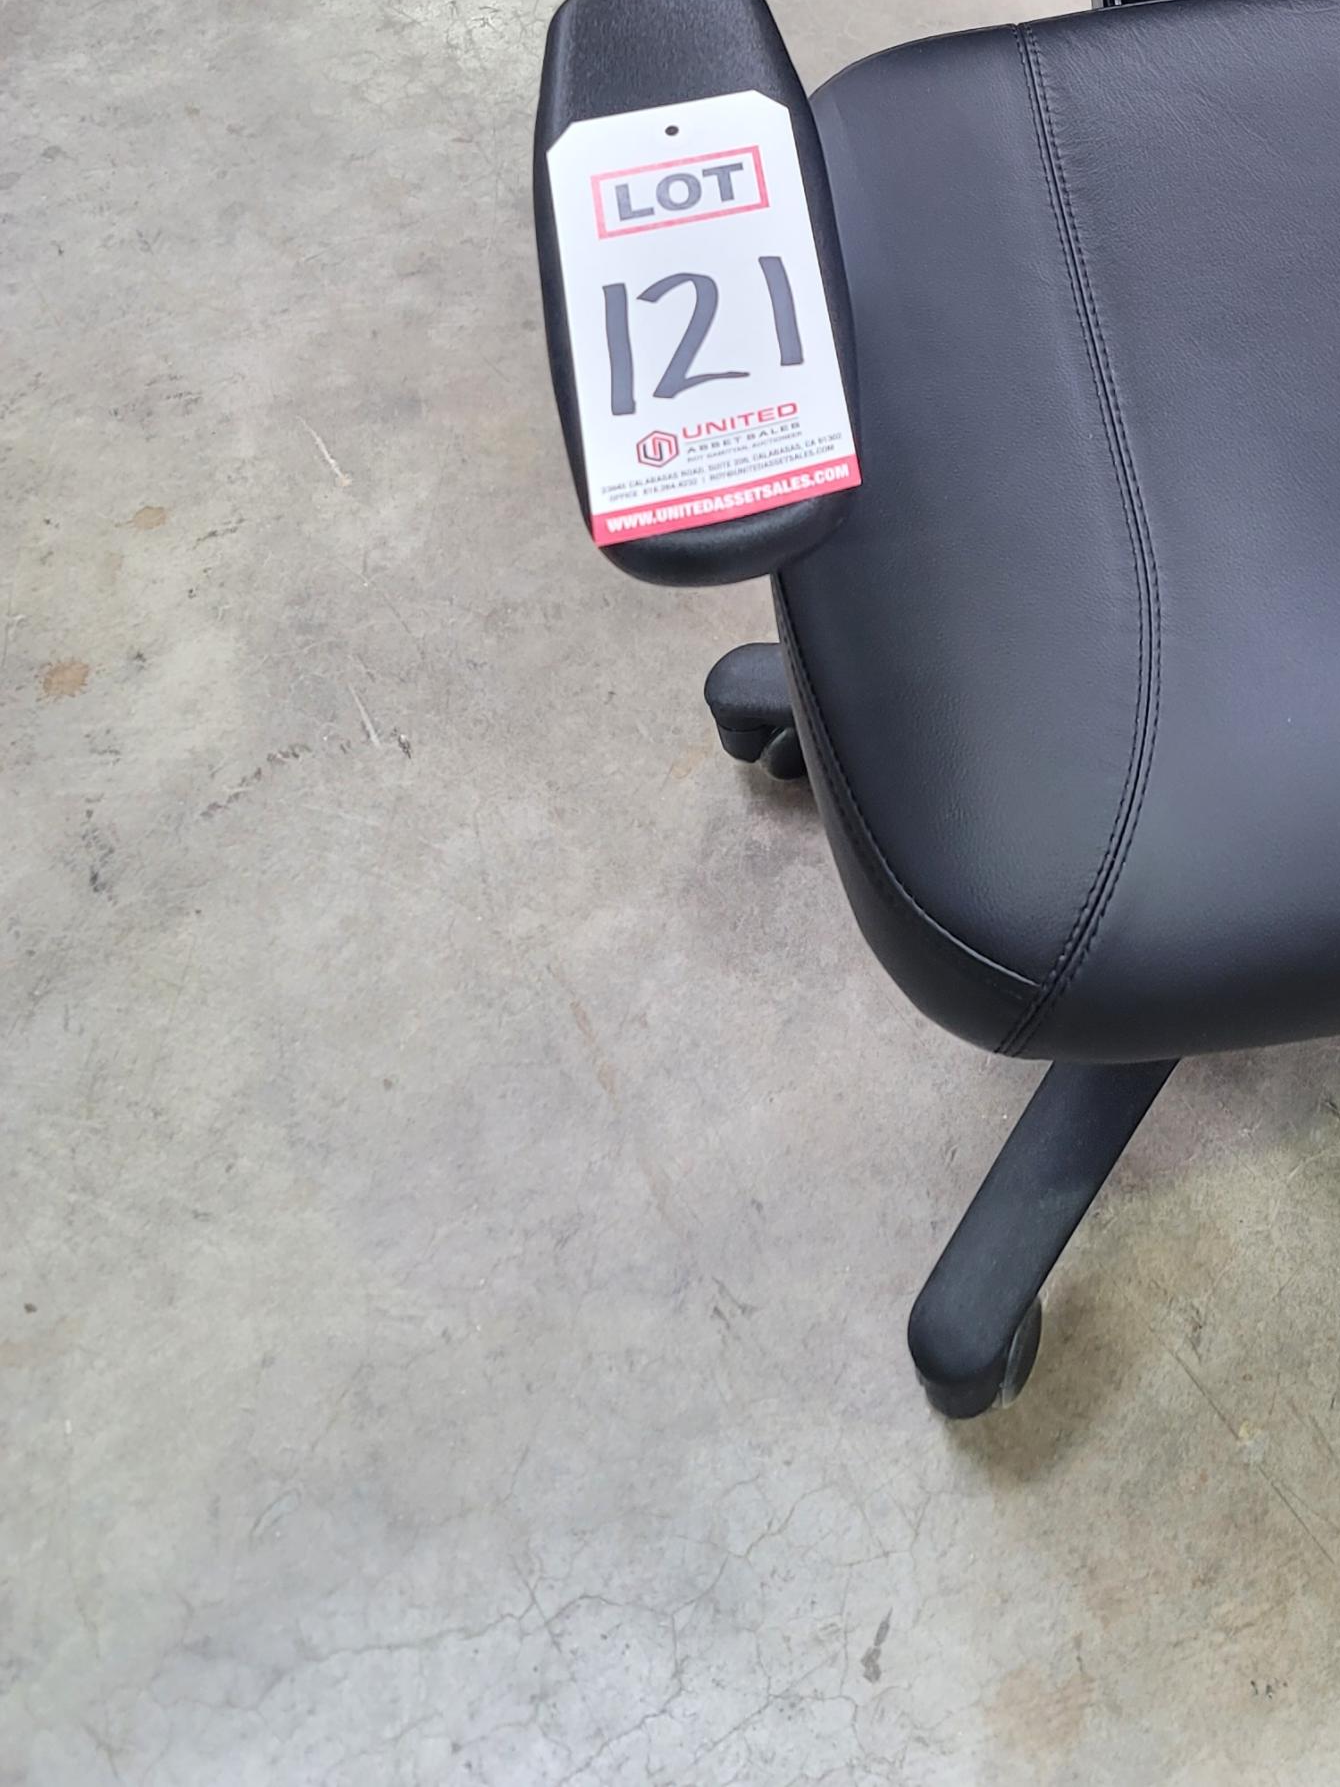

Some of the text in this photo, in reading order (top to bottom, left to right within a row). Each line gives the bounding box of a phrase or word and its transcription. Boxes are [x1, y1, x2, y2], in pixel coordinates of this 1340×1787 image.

[614, 161, 744, 222] LOT
[602, 255, 805, 416] 121
[682, 402, 798, 440] UNITED
[687, 421, 800, 454] ASSET SALES
[605, 464, 850, 533] WWW.UNITEDASSETSALES.COM
